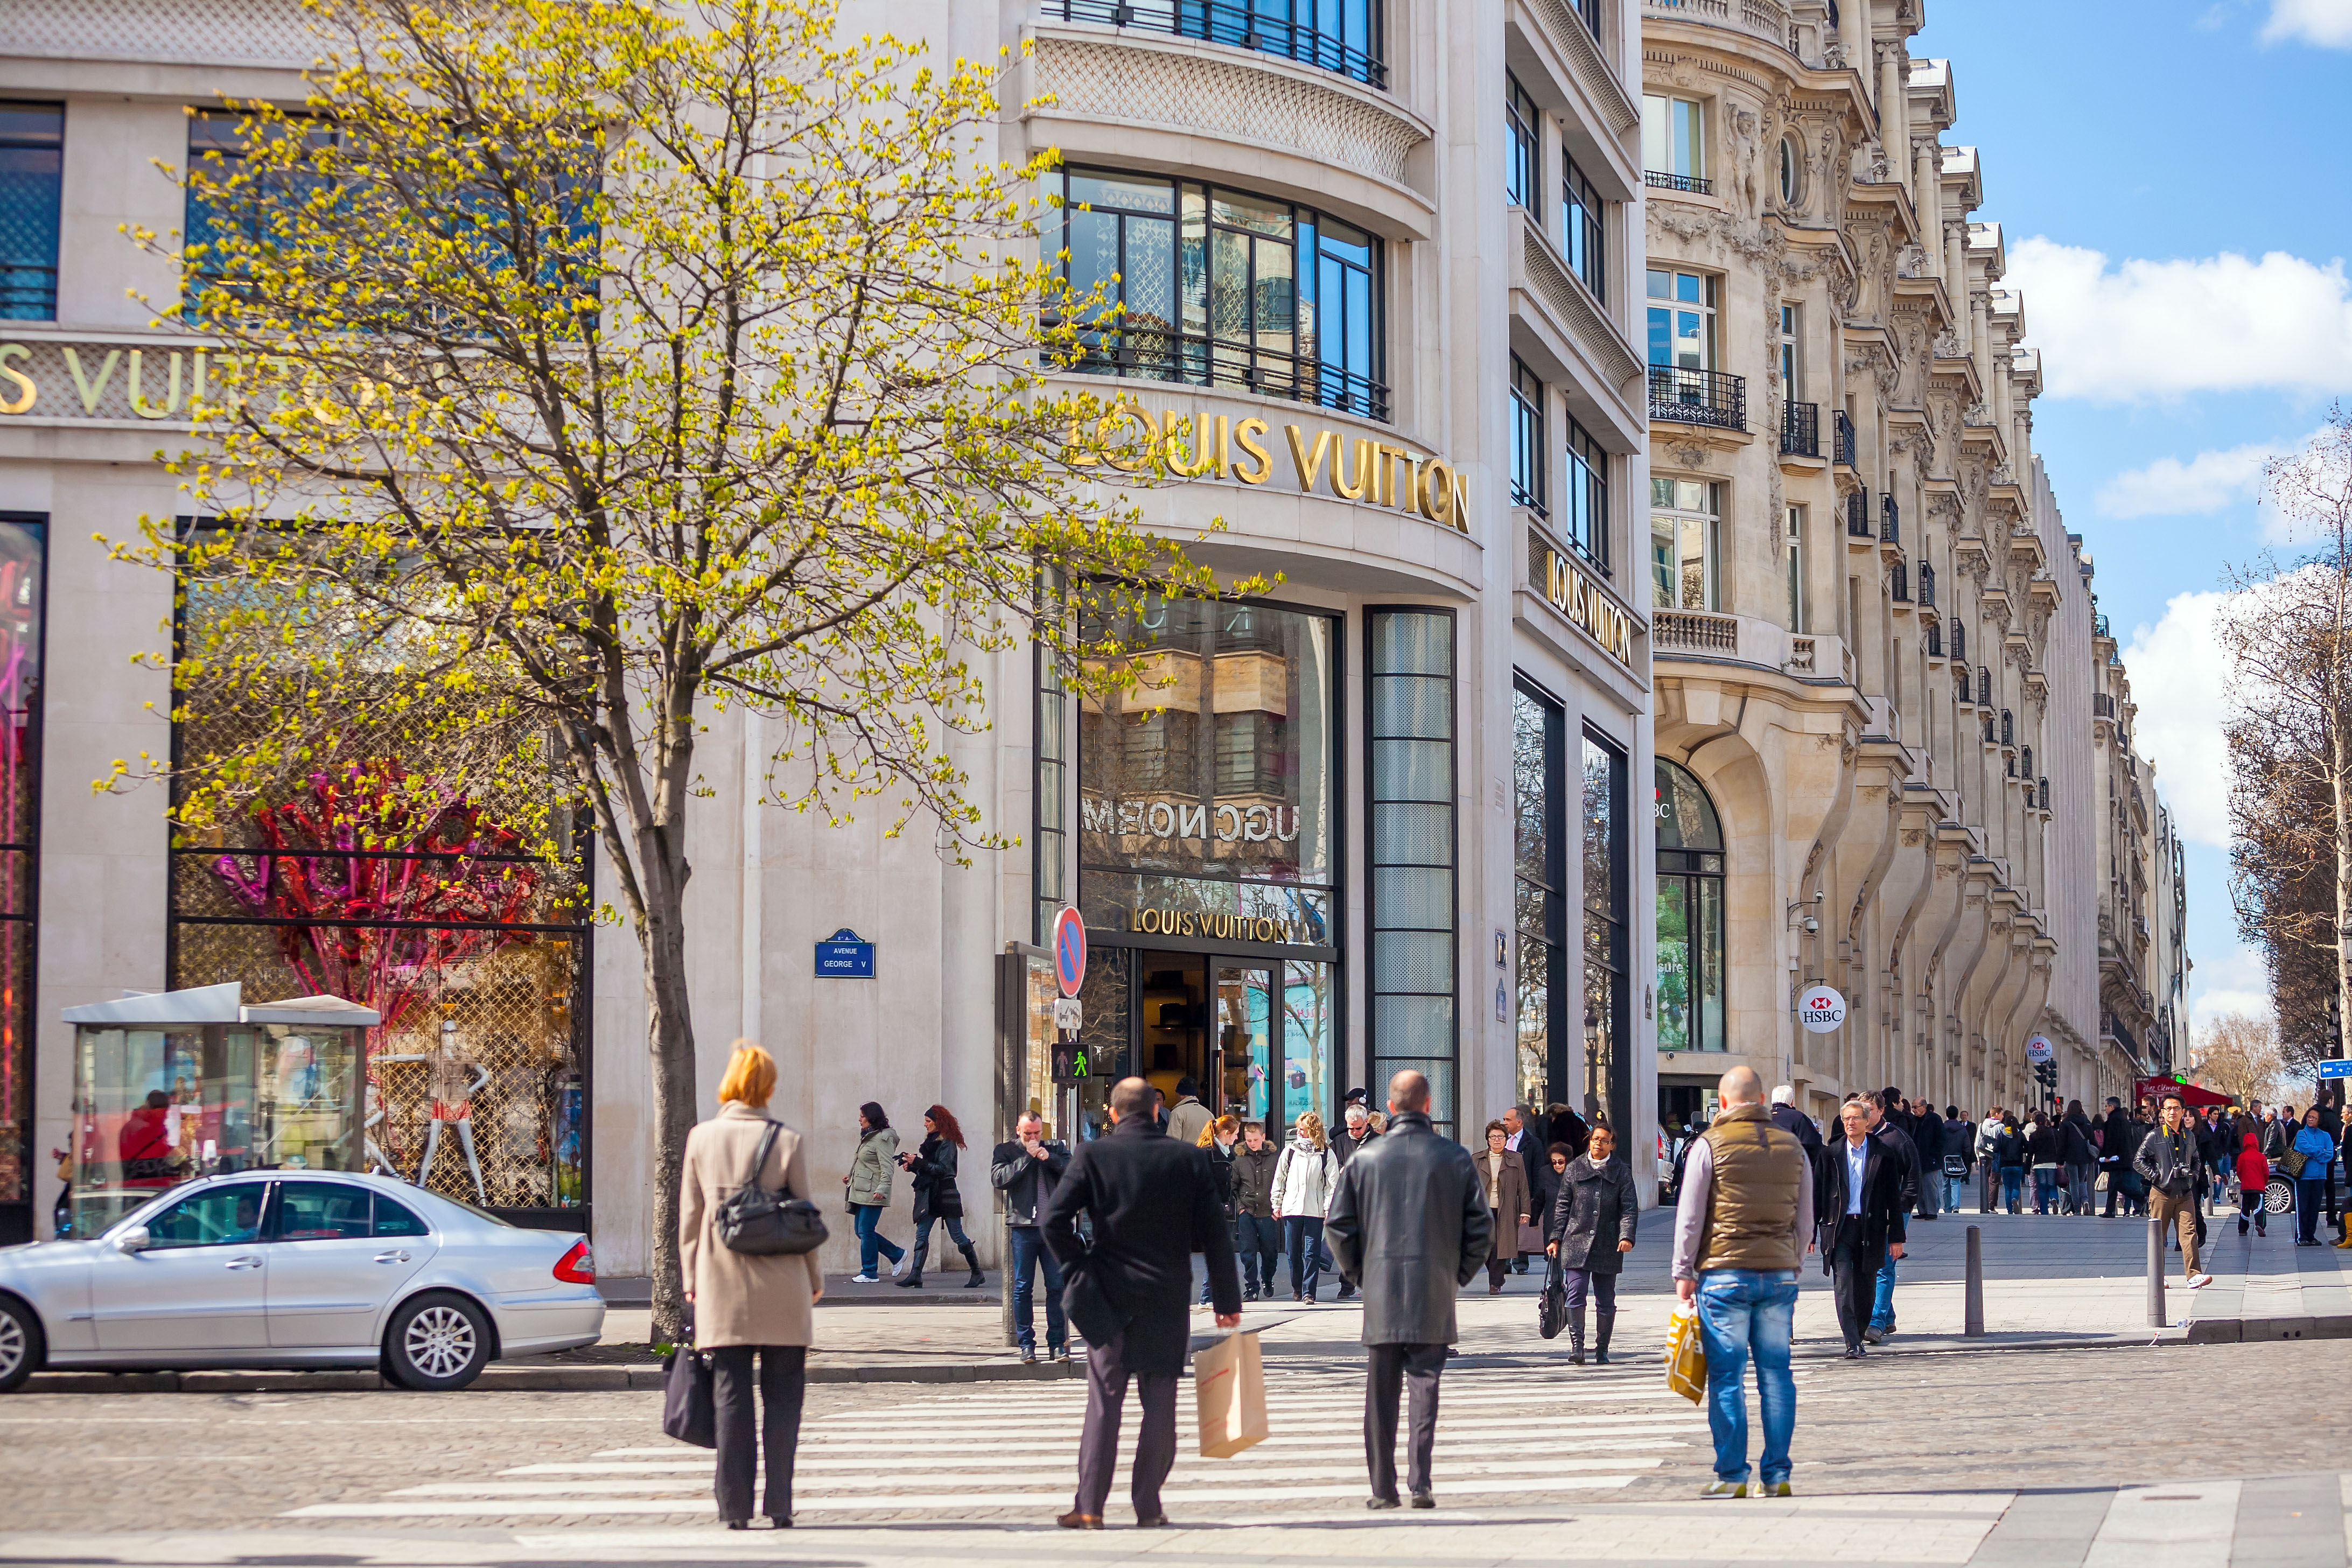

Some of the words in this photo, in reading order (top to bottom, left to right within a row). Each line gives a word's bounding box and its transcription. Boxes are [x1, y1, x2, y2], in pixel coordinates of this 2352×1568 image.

[1067, 402, 1272, 485] LOUIS
[1284, 424, 1469, 535] VUITTON
[1546, 550, 1585, 628] LOUIS
[1586, 580, 1631, 668] VUITTON
[1655, 803, 1670, 818] BC
[1131, 907, 1194, 936] LOUIS
[1198, 913, 1289, 943] VUITTON
[1803, 1010, 1842, 1023] HSBC
